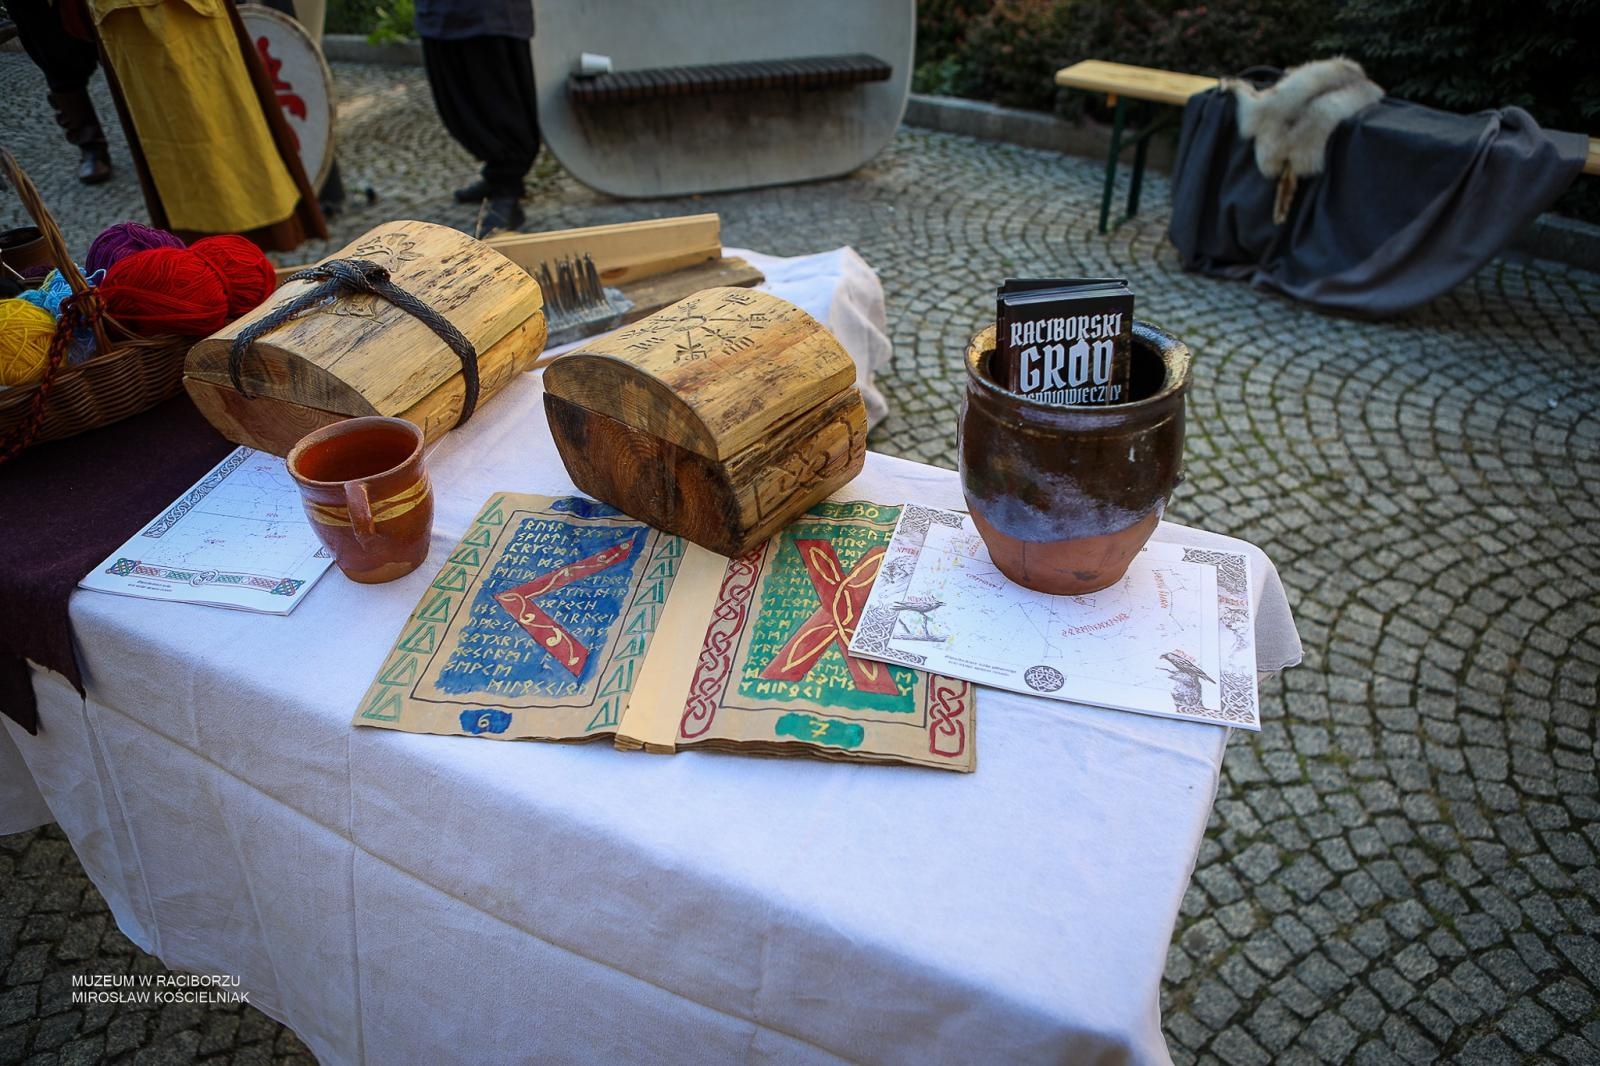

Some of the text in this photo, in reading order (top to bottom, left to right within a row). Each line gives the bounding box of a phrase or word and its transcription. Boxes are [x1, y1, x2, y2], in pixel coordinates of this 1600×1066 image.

[1009, 313, 1123, 348] RACIBORSKI
[477, 713, 491, 728] 6
[809, 719, 830, 738] 7
